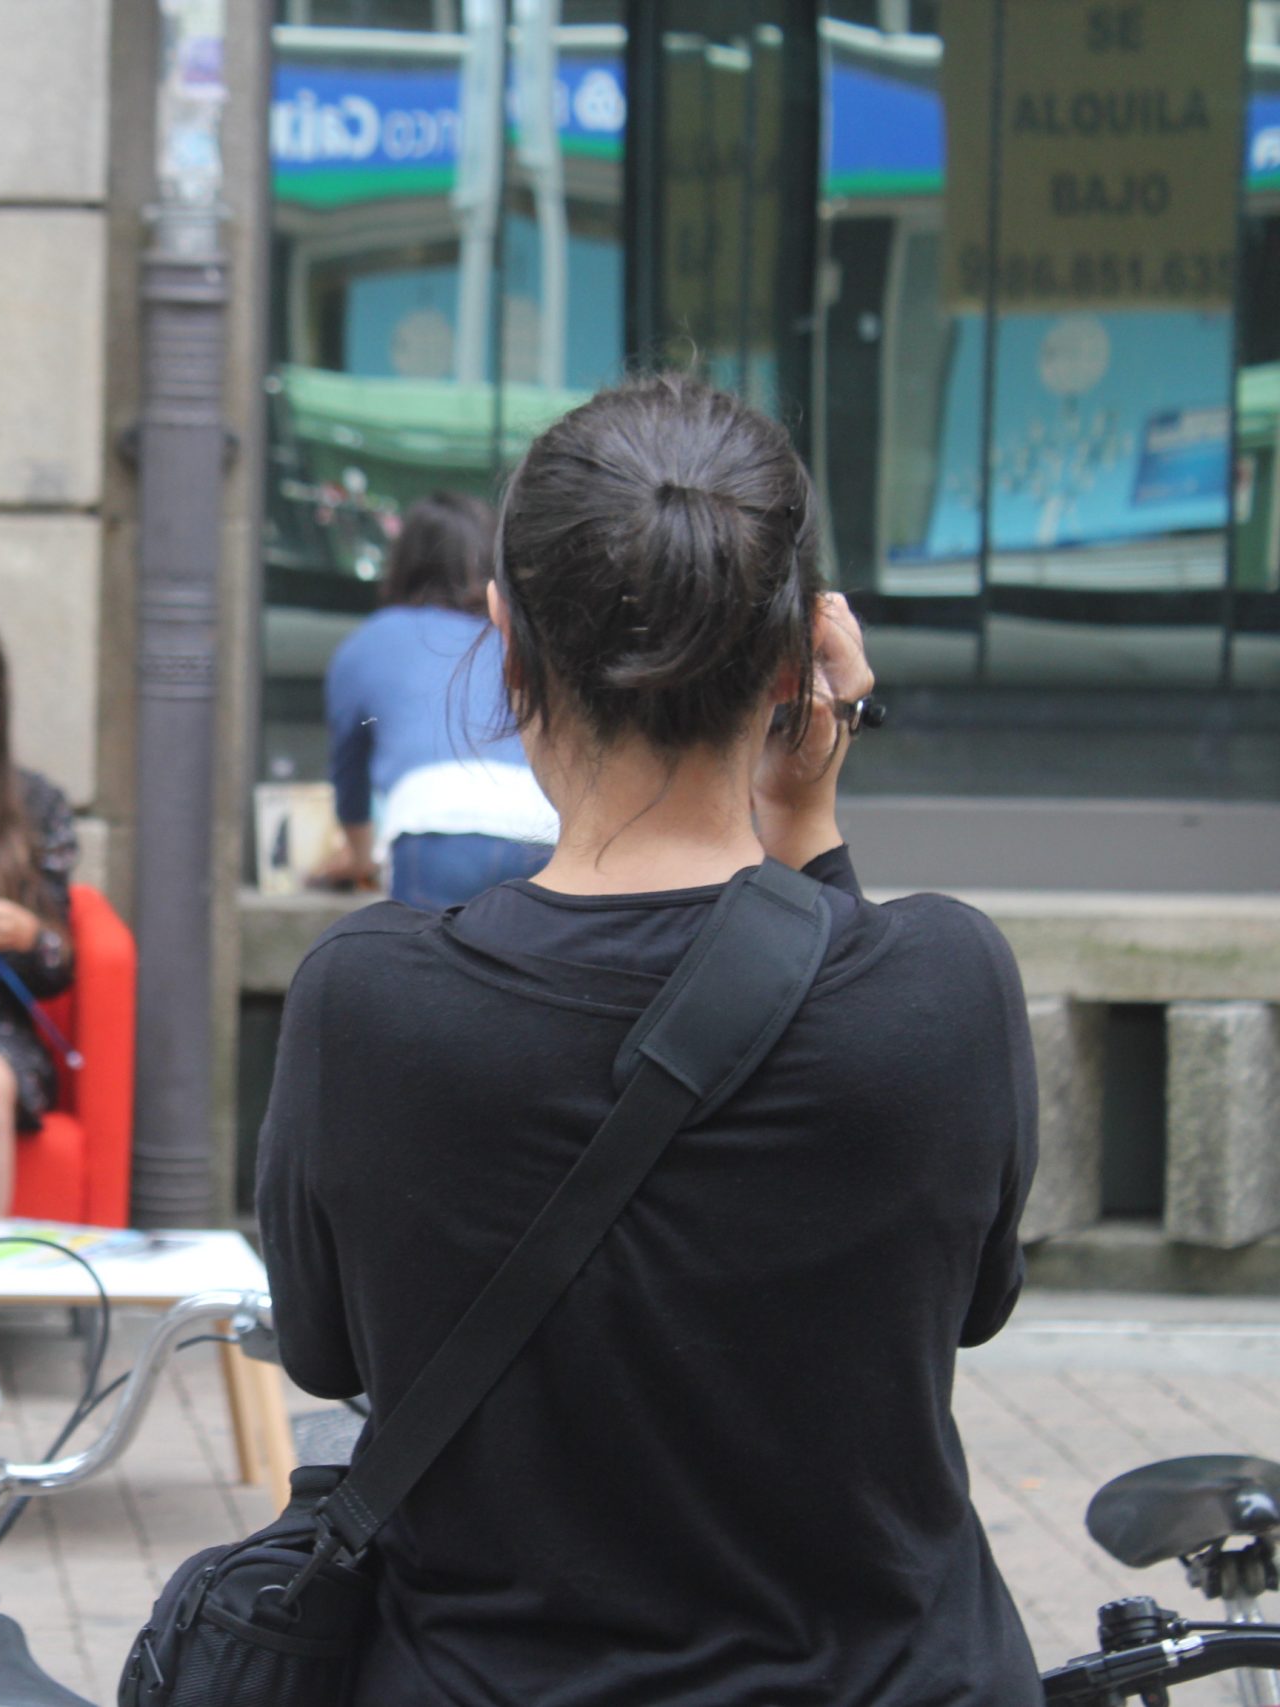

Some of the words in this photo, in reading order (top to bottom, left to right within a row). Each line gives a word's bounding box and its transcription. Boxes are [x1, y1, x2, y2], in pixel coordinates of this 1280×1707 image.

[1088, 6, 1144, 52] SE
[1013, 87, 1210, 138] ALQUILA
[1050, 169, 1173, 217] BAJO
